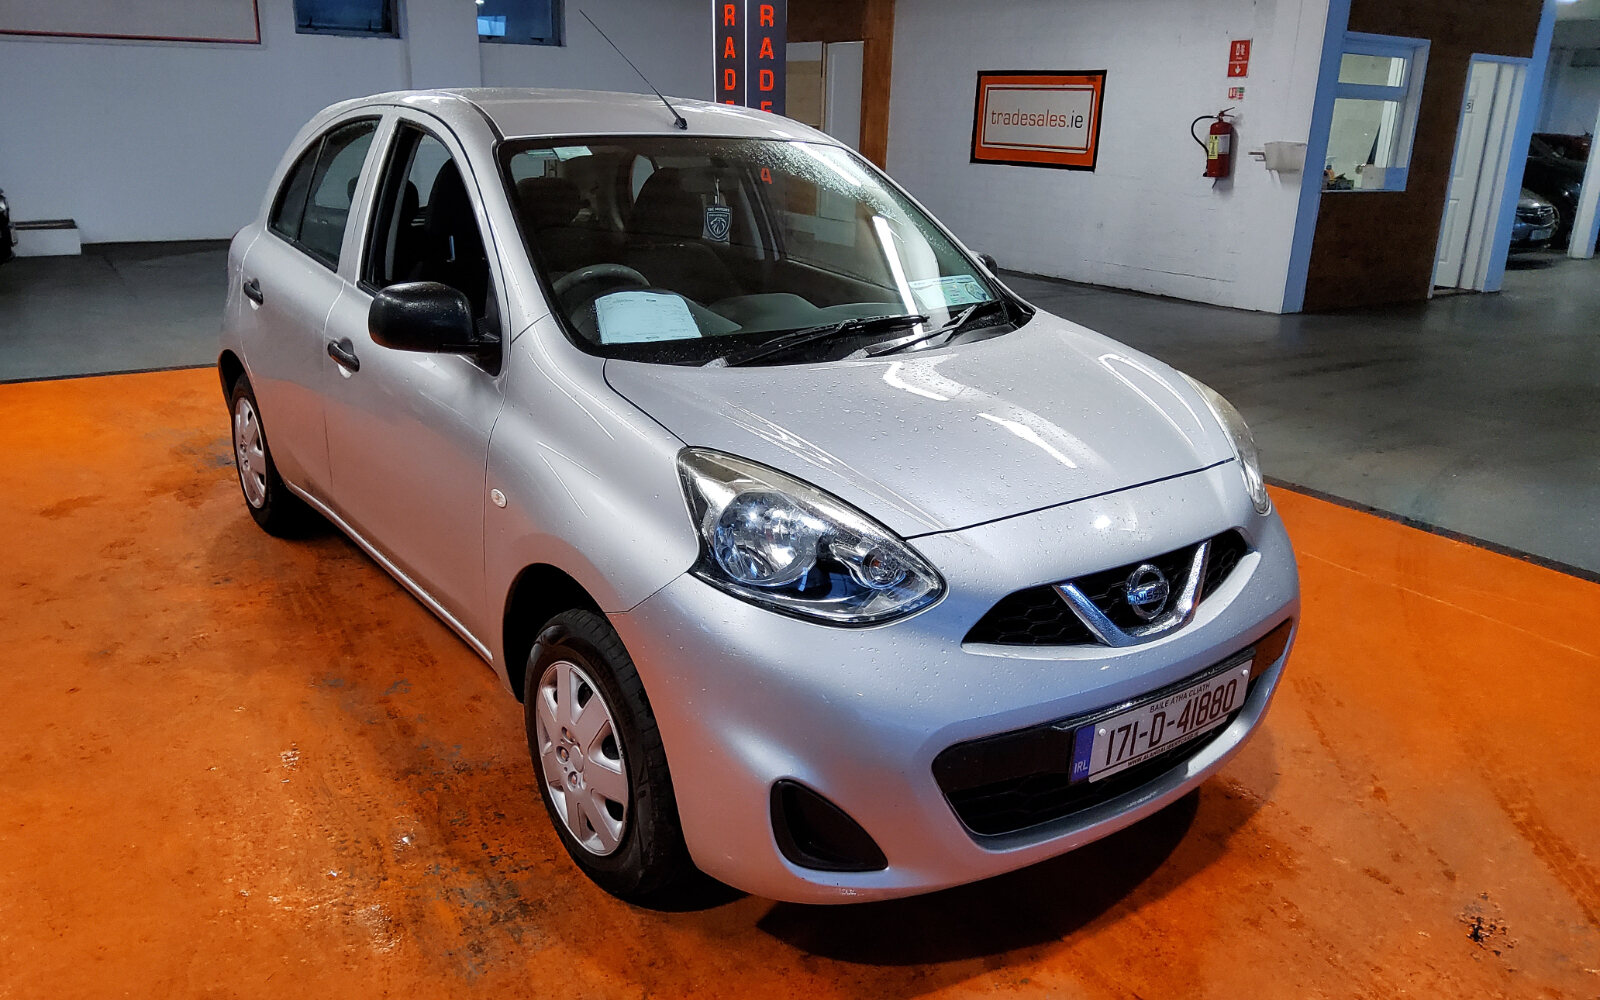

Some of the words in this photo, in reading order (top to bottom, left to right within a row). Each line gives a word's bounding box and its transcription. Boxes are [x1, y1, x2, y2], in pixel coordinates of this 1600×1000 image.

[724, 4, 736, 105] RAD
[991, 108, 1084, 129] tradesales.ie
[1150, 699, 1169, 713] BAILE
[1106, 678, 1238, 766] 171-D-41880
[1073, 759, 1088, 774] IRL
